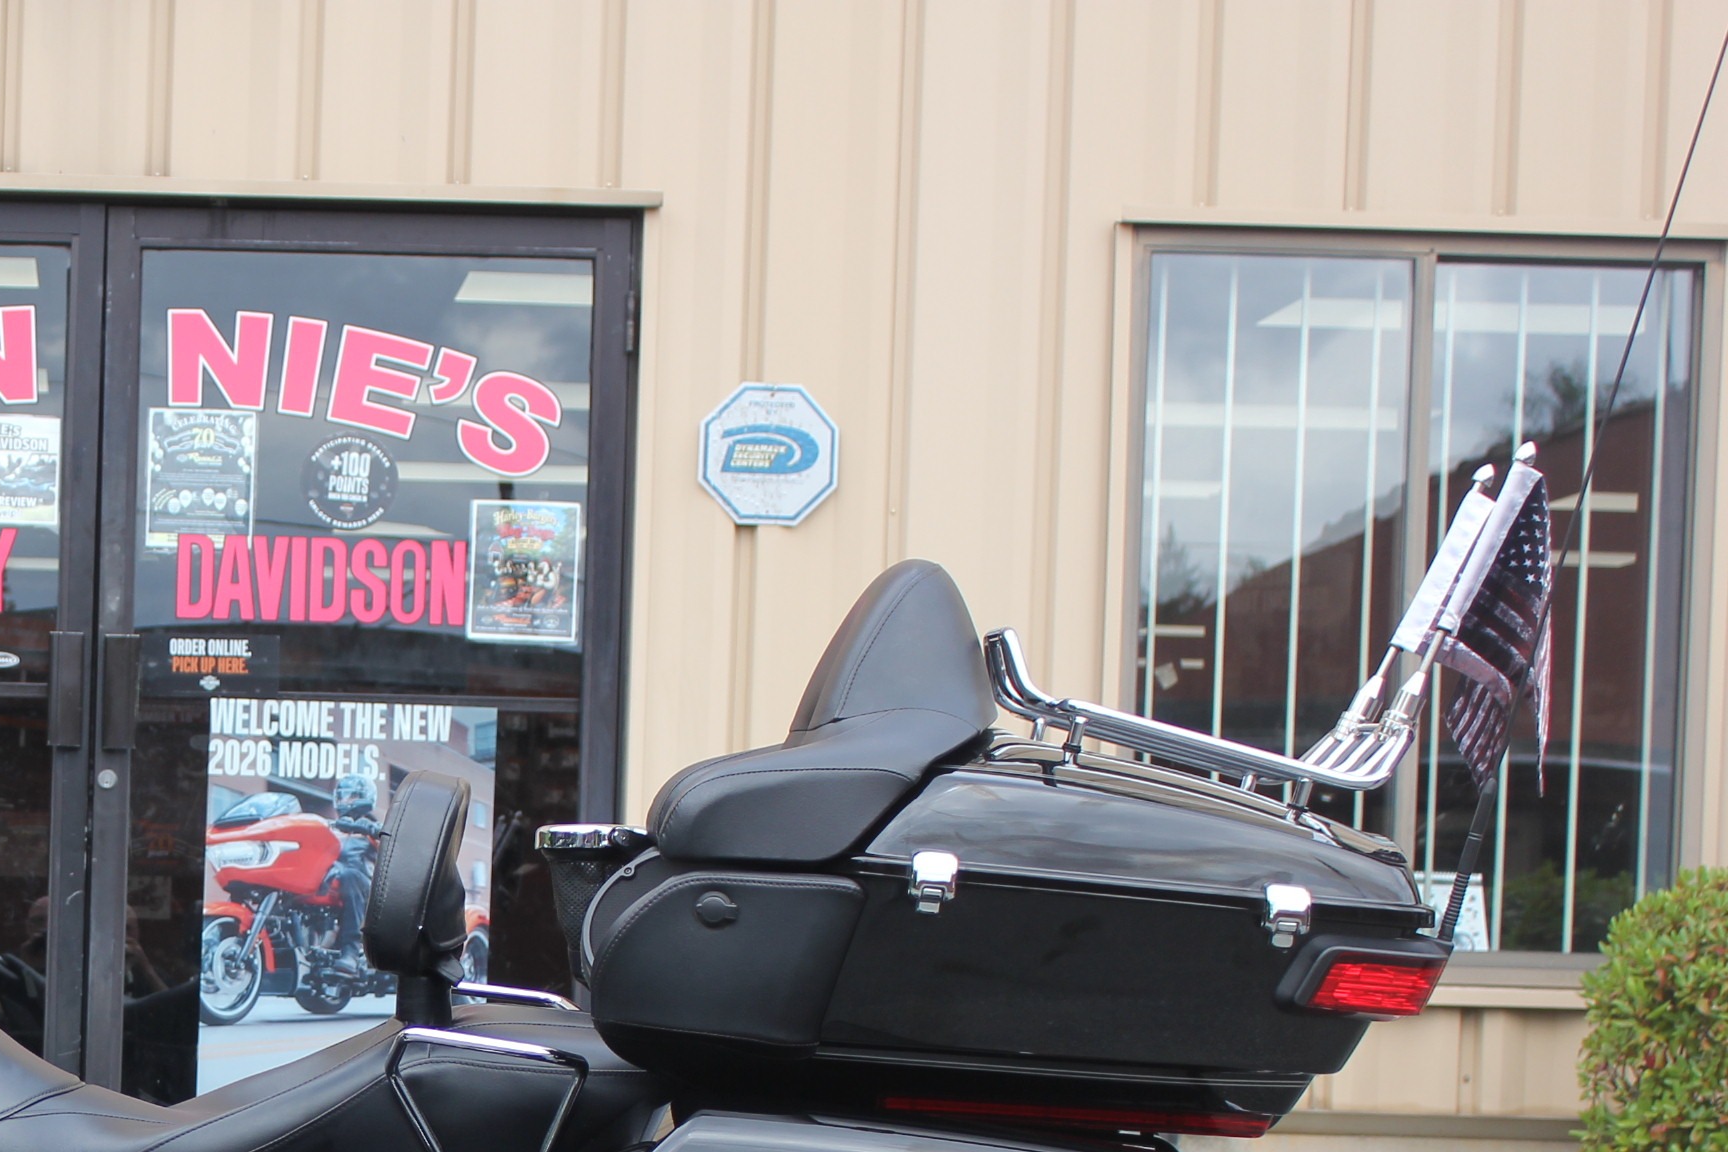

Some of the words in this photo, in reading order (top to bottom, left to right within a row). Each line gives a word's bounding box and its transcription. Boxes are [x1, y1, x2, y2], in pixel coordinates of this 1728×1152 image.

[167, 308, 562, 478] NIE'S
[192, 427, 215, 445] 70
[331, 451, 371, 477] +100
[328, 474, 369, 494] POINTS
[175, 533, 469, 627] DAVIDSON
[169, 637, 206, 656] ORDER
[207, 638, 252, 657] ONLINE.
[172, 656, 198, 672] PICK
[200, 656, 216, 673] UP
[217, 657, 249, 674] HERE.
[209, 697, 335, 738] WELCOME
[339, 701, 389, 740] THE
[392, 704, 453, 743] NEW
[208, 739, 272, 777] 2026
[278, 742, 386, 781] MODELS.
